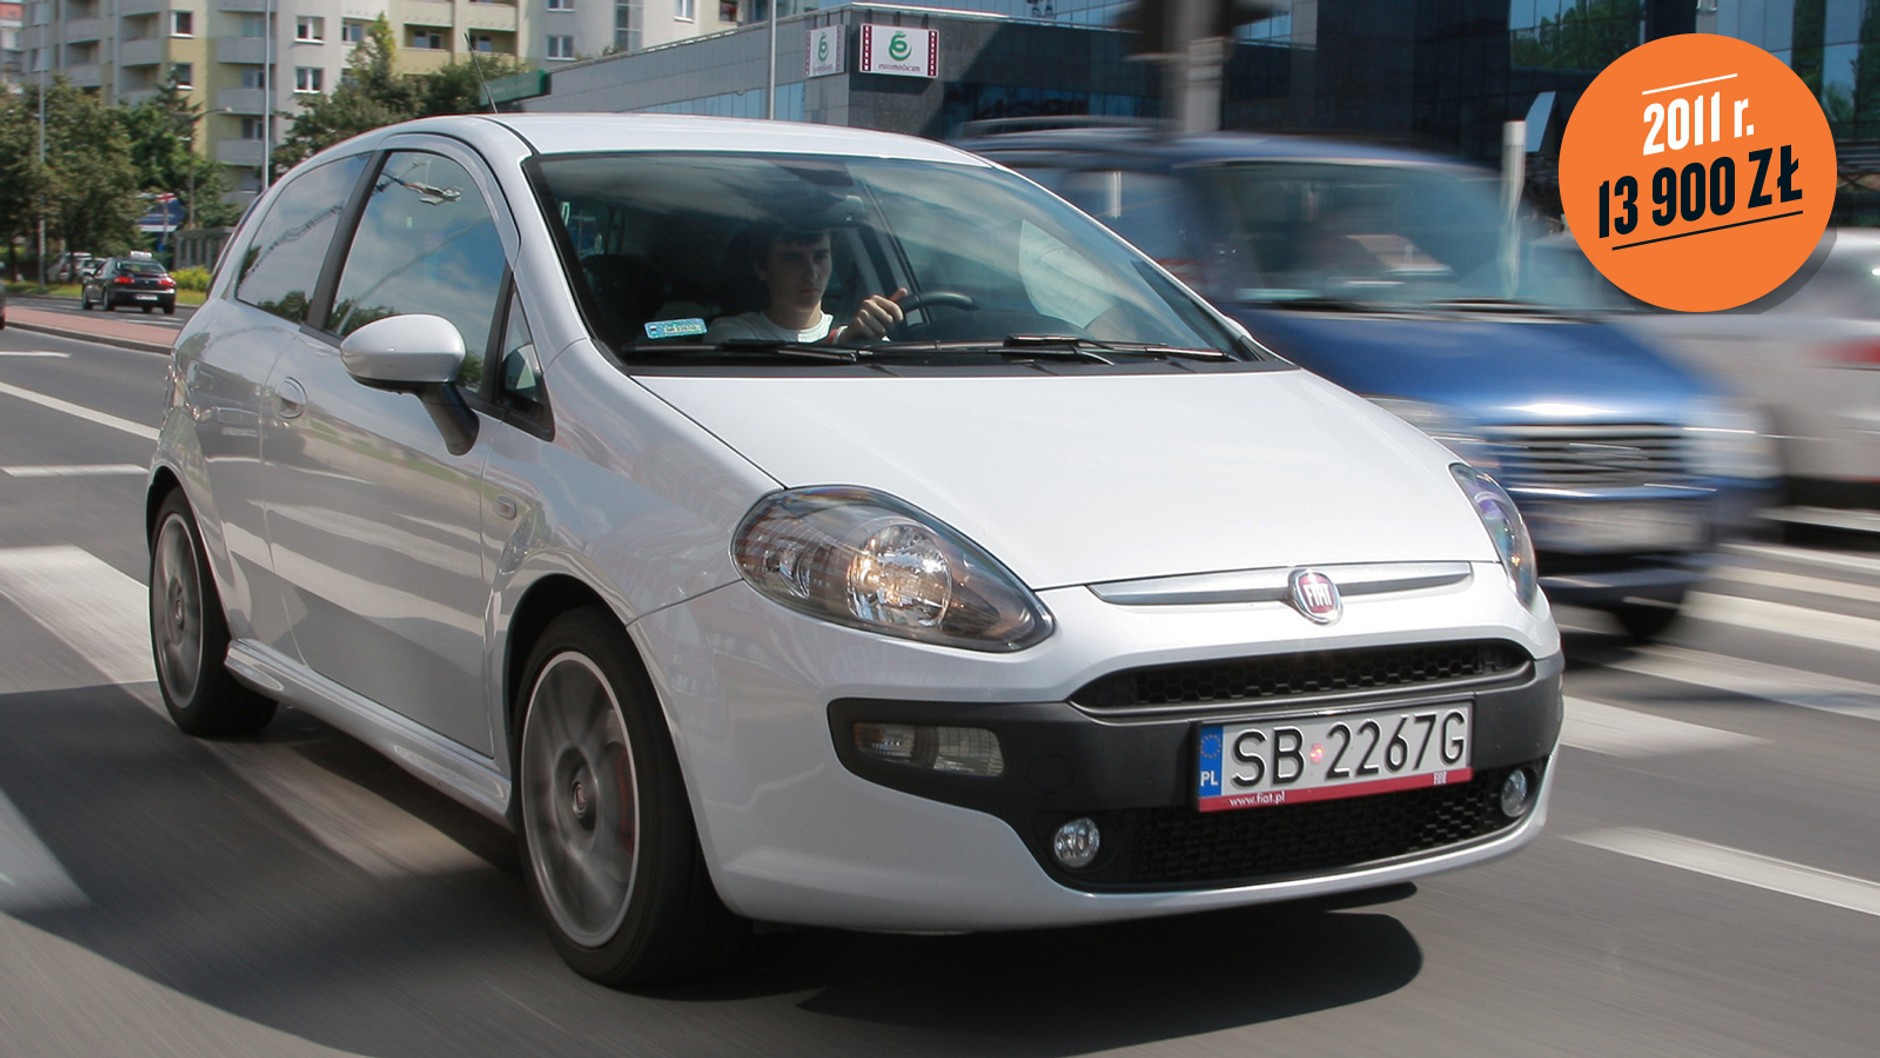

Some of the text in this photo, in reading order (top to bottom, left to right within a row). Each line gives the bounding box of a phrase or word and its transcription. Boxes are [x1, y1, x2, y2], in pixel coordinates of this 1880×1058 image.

[1303, 583, 1333, 607] FIAT
[1231, 709, 1467, 788] SB 2267G
[1200, 770, 1219, 787] PL
[1229, 790, 1286, 806] www.fiat.pl
